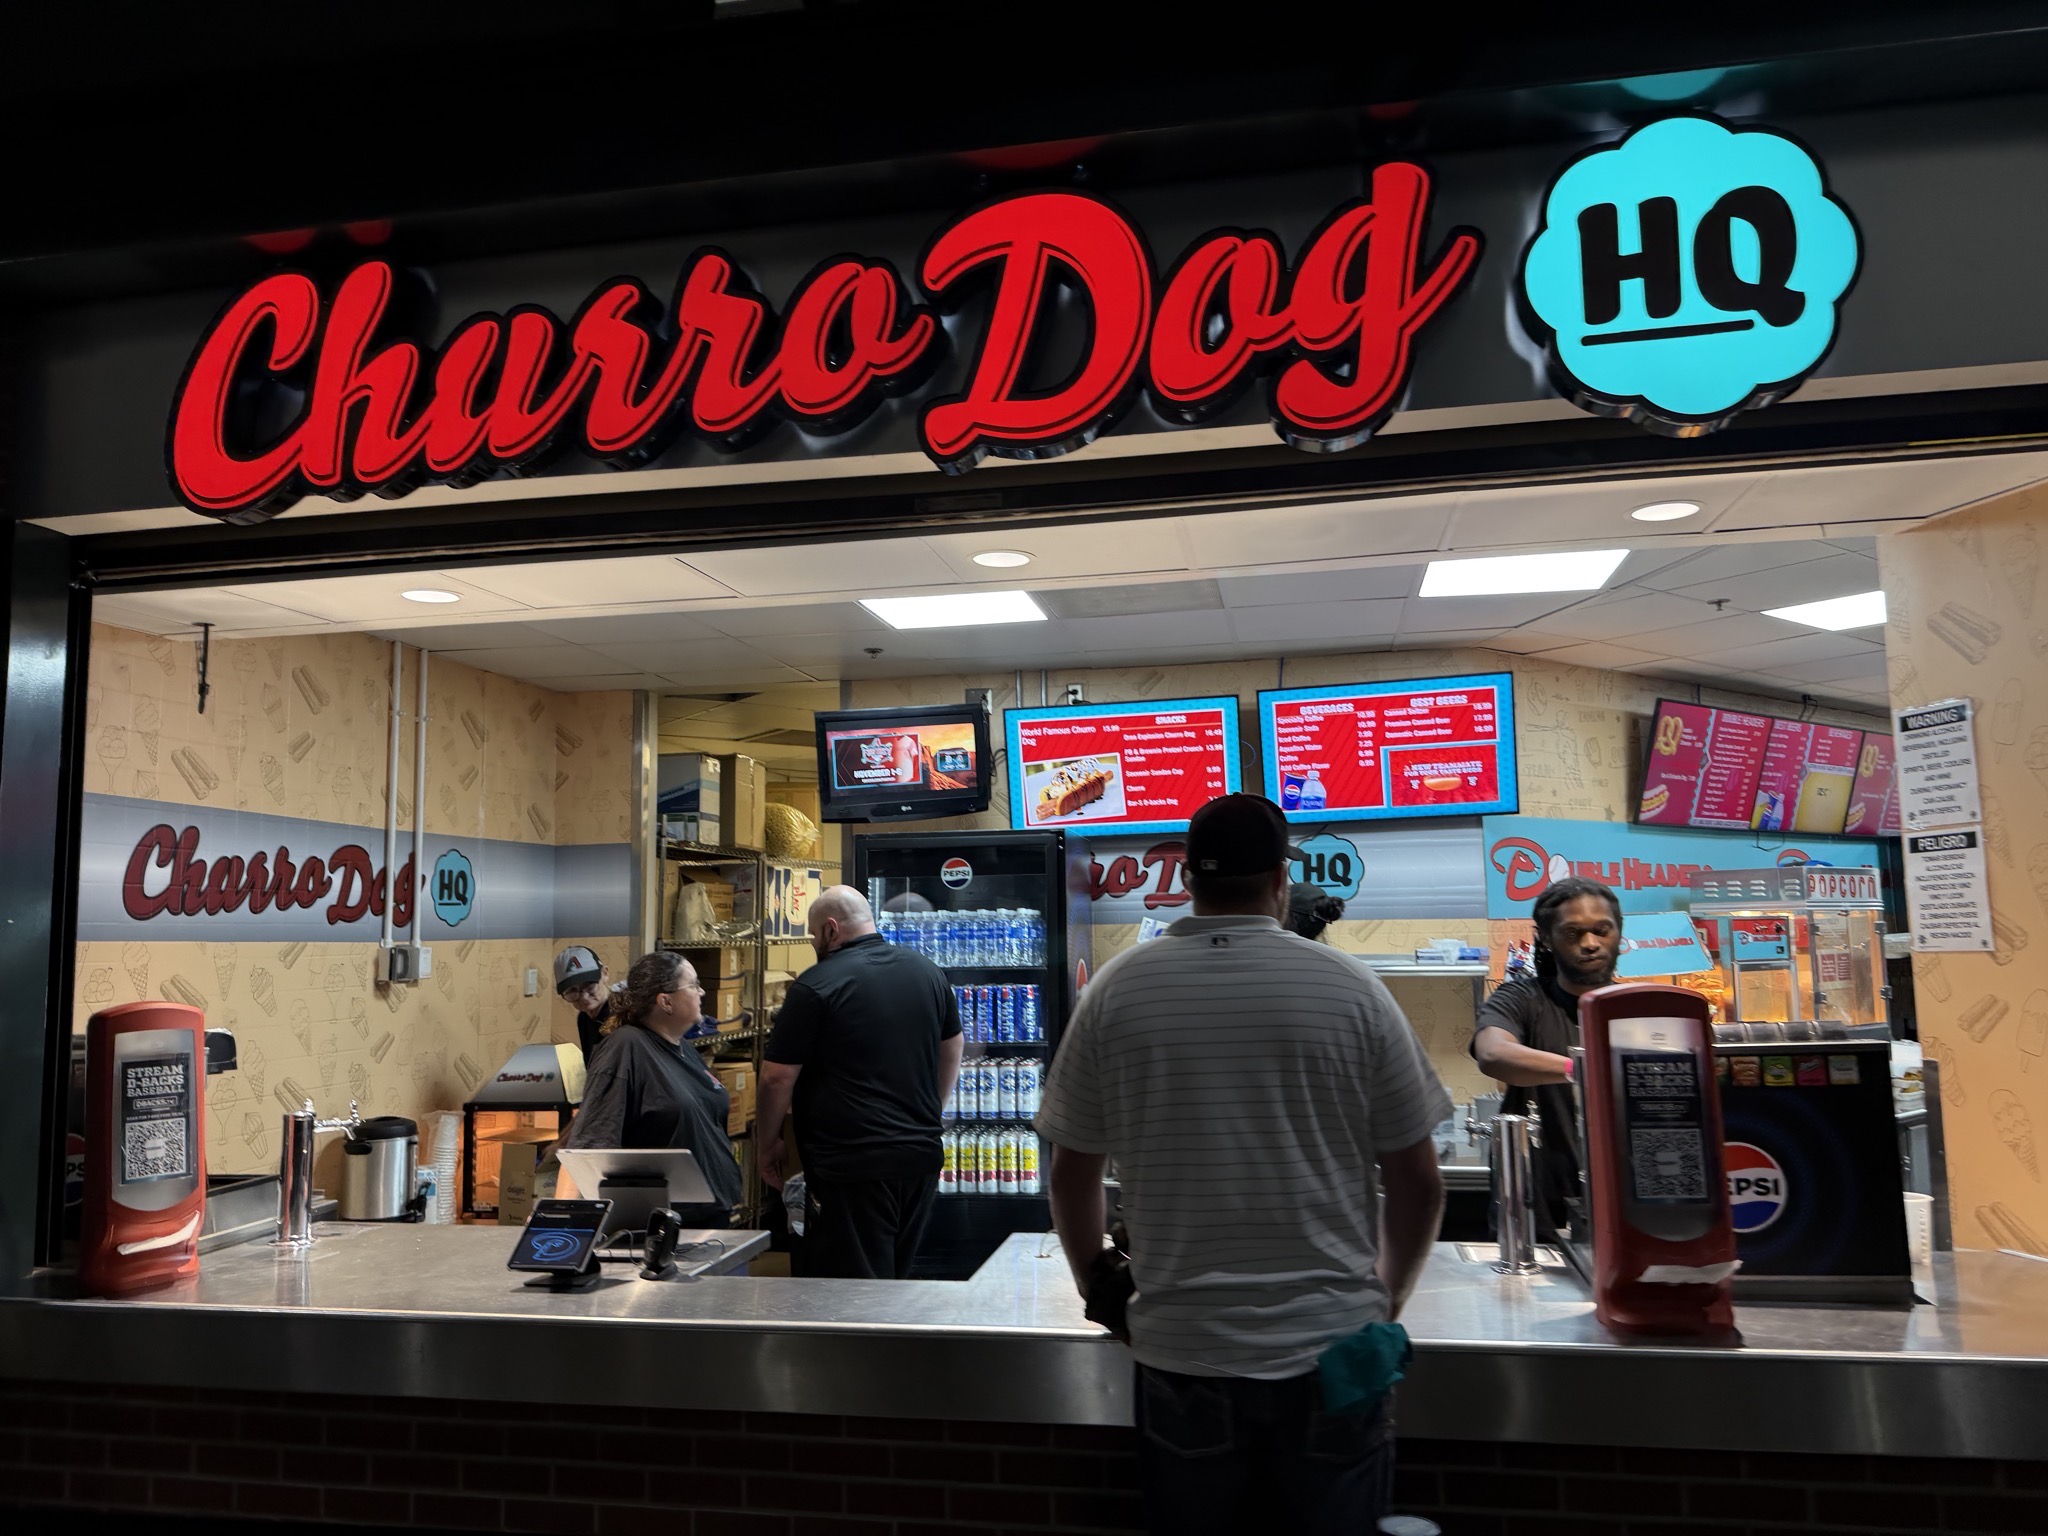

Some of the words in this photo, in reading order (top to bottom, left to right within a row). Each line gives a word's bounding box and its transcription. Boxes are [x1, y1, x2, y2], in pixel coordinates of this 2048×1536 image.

[1577, 185, 1806, 328] HQ
[172, 258, 936, 512] Churro
[921, 161, 1482, 459] Dog
[1300, 703, 1354, 715] BEVERAGES
[1906, 709, 1958, 729] WARNING
[1020, 727, 1042, 736] World
[1042, 726, 1071, 735] Famous
[1071, 725, 1096, 734] Churro
[1022, 737, 1037, 746] Dog
[1918, 835, 1968, 851] PELIGRO
[122, 823, 333, 921] Churro
[1302, 851, 1353, 887] HQ
[439, 869, 468, 906] HQ
[1002, 1002, 1011, 1033] ULTRA
[127, 1064, 184, 1078] STREAM
[1626, 1062, 1693, 1074] STREAM
[127, 1075, 184, 1088] D-BACKS
[1627, 1075, 1694, 1087] D-BACKS
[127, 1085, 185, 1097] BASEBALL
[1628, 1087, 1696, 1097] BASEBALL
